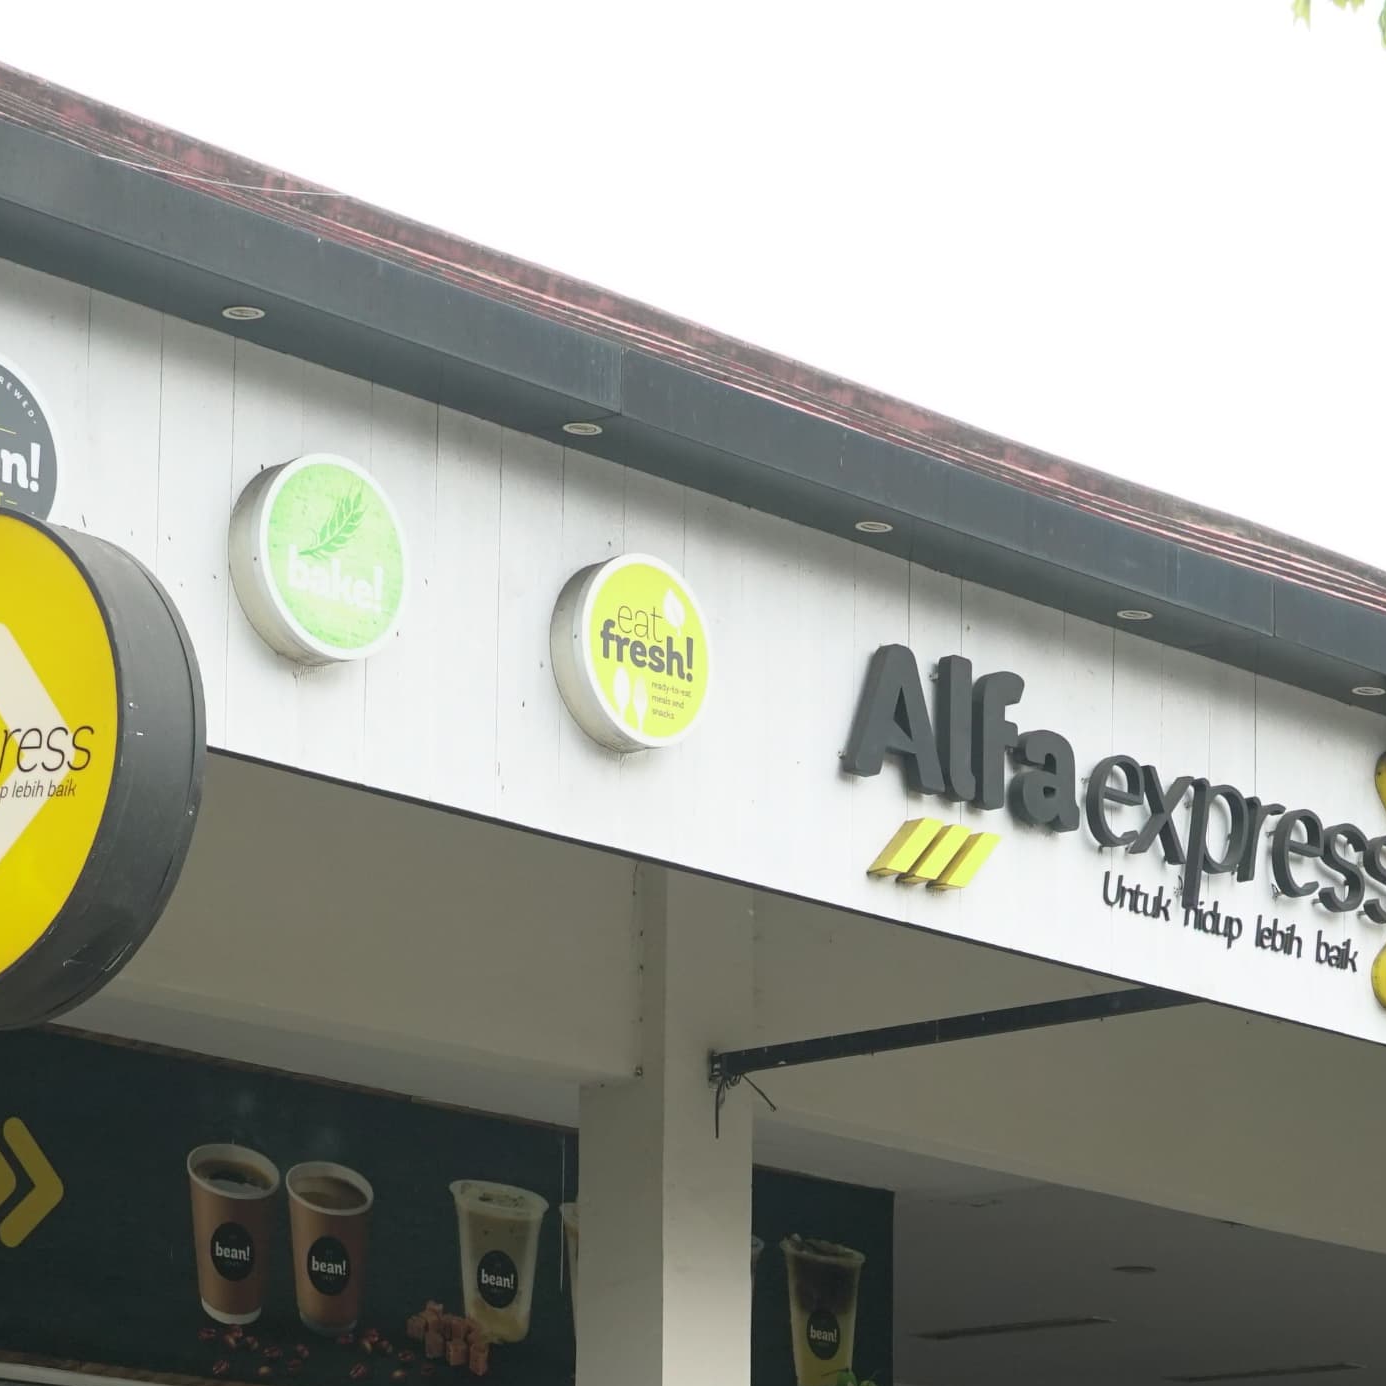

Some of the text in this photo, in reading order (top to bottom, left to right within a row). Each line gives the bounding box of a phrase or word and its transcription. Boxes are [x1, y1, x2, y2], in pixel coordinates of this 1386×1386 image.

[287, 543, 384, 614] bake!
[617, 604, 663, 643] eat
[599, 618, 694, 683] fresh!
[12, 780, 44, 798] lebih
[47, 778, 77, 798] baik
[1102, 871, 1171, 924] Untuk
[1255, 915, 1303, 958] lebih
[1316, 931, 1359, 973] baik
[215, 1241, 251, 1261] bean!
[312, 1256, 347, 1276] bean!
[481, 1268, 515, 1290] bean!
[810, 1323, 837, 1344] bean!
